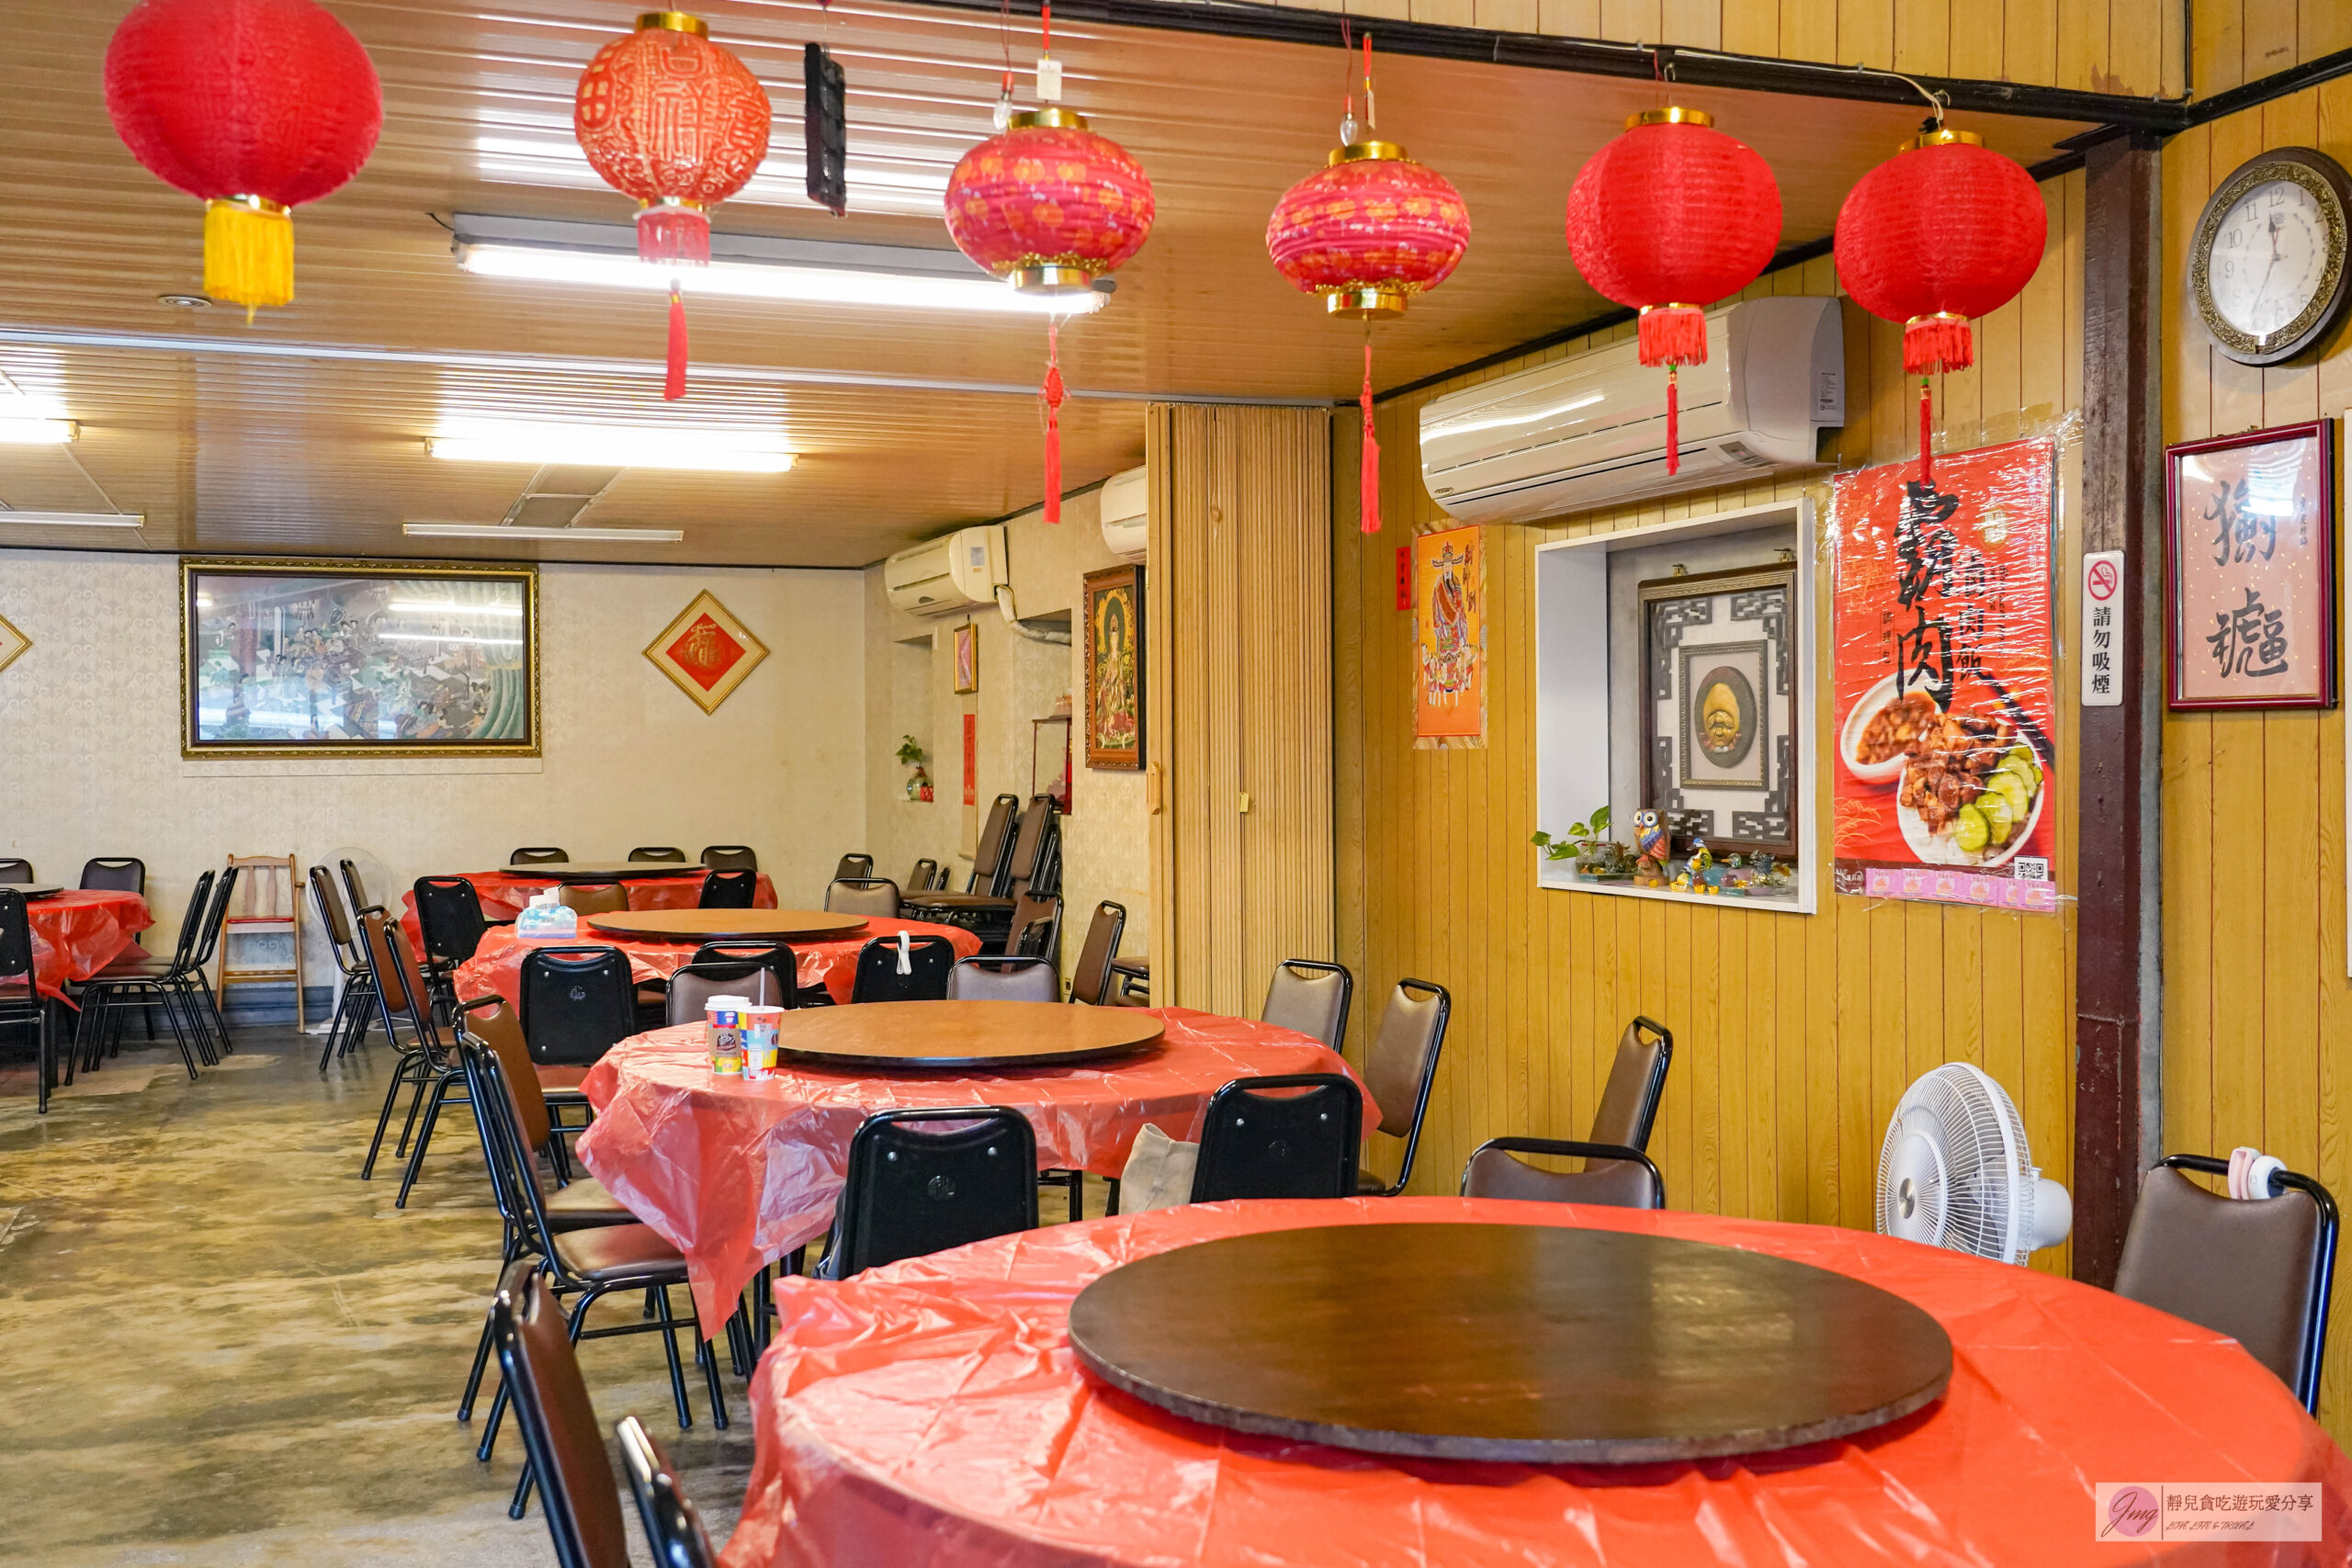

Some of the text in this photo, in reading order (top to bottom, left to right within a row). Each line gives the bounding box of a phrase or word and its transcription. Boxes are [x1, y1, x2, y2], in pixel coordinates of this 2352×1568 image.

[2267, 186, 2286, 209] 12
[2298, 188, 2306, 207] 1
[2245, 202, 2259, 222] 11
[2313, 205, 2324, 224] 2
[2224, 229, 2244, 249] 10
[2224, 261, 2235, 279] 9
[2274, 308, 2284, 325] 6
[2092, 606, 2111, 694] 請勿吸煙
